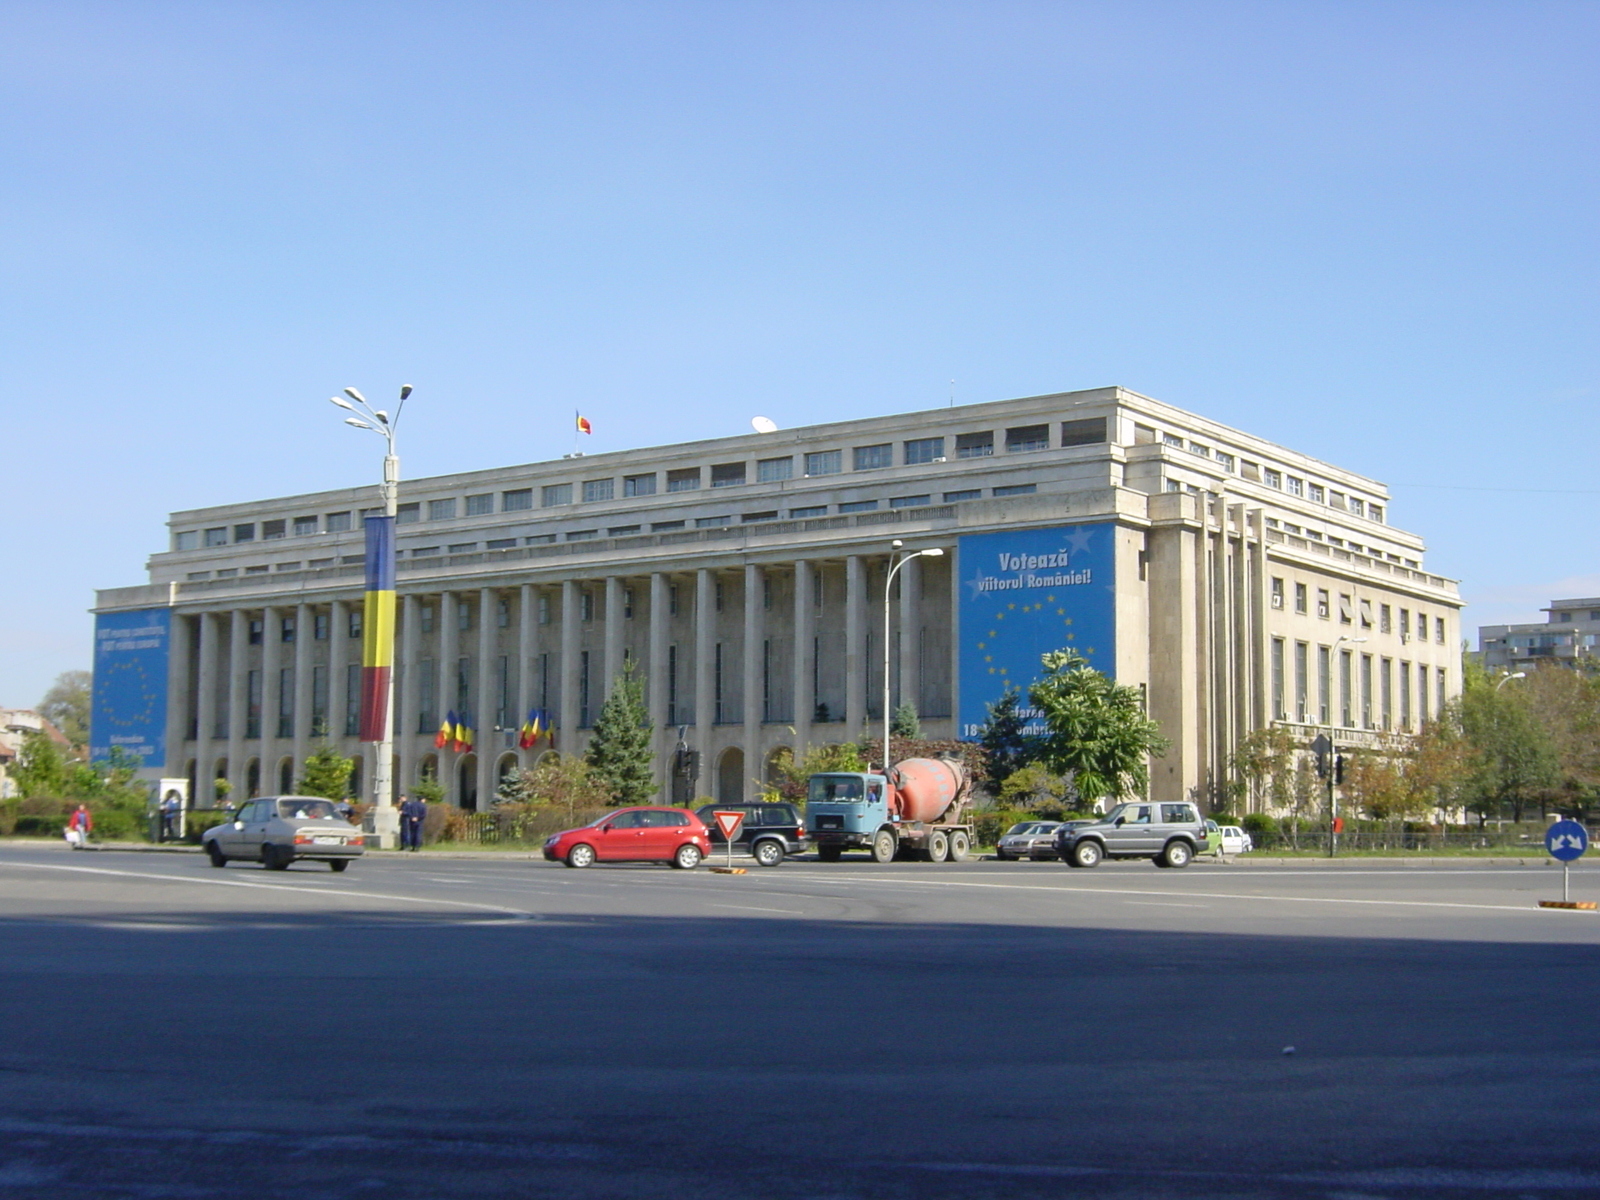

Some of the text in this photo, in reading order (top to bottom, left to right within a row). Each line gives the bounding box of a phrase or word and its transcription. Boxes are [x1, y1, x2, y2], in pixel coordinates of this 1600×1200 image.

[999, 548, 1068, 572] Votează
[978, 569, 1092, 592] viitorul României!
